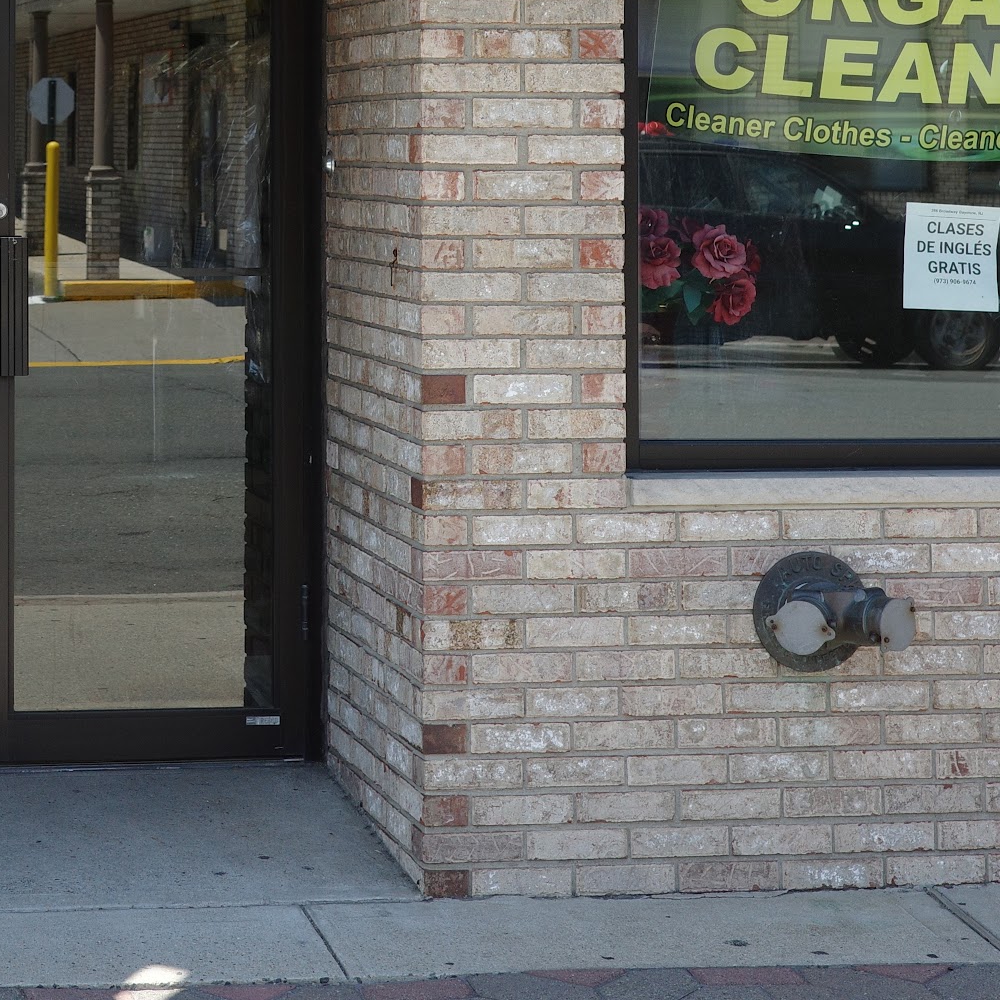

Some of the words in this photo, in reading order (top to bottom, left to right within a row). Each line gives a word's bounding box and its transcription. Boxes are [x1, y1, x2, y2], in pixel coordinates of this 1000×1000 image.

[693, 26, 1000, 105] CLEAN
[665, 101, 776, 139] Cleaner
[782, 115, 893, 147] Clothes
[918, 122, 1000, 150] Clean
[927, 221, 985, 236] CLASES
[917, 240, 935, 253] DE
[939, 240, 992, 256] INGLÉS
[928, 260, 981, 275] GRATIS
